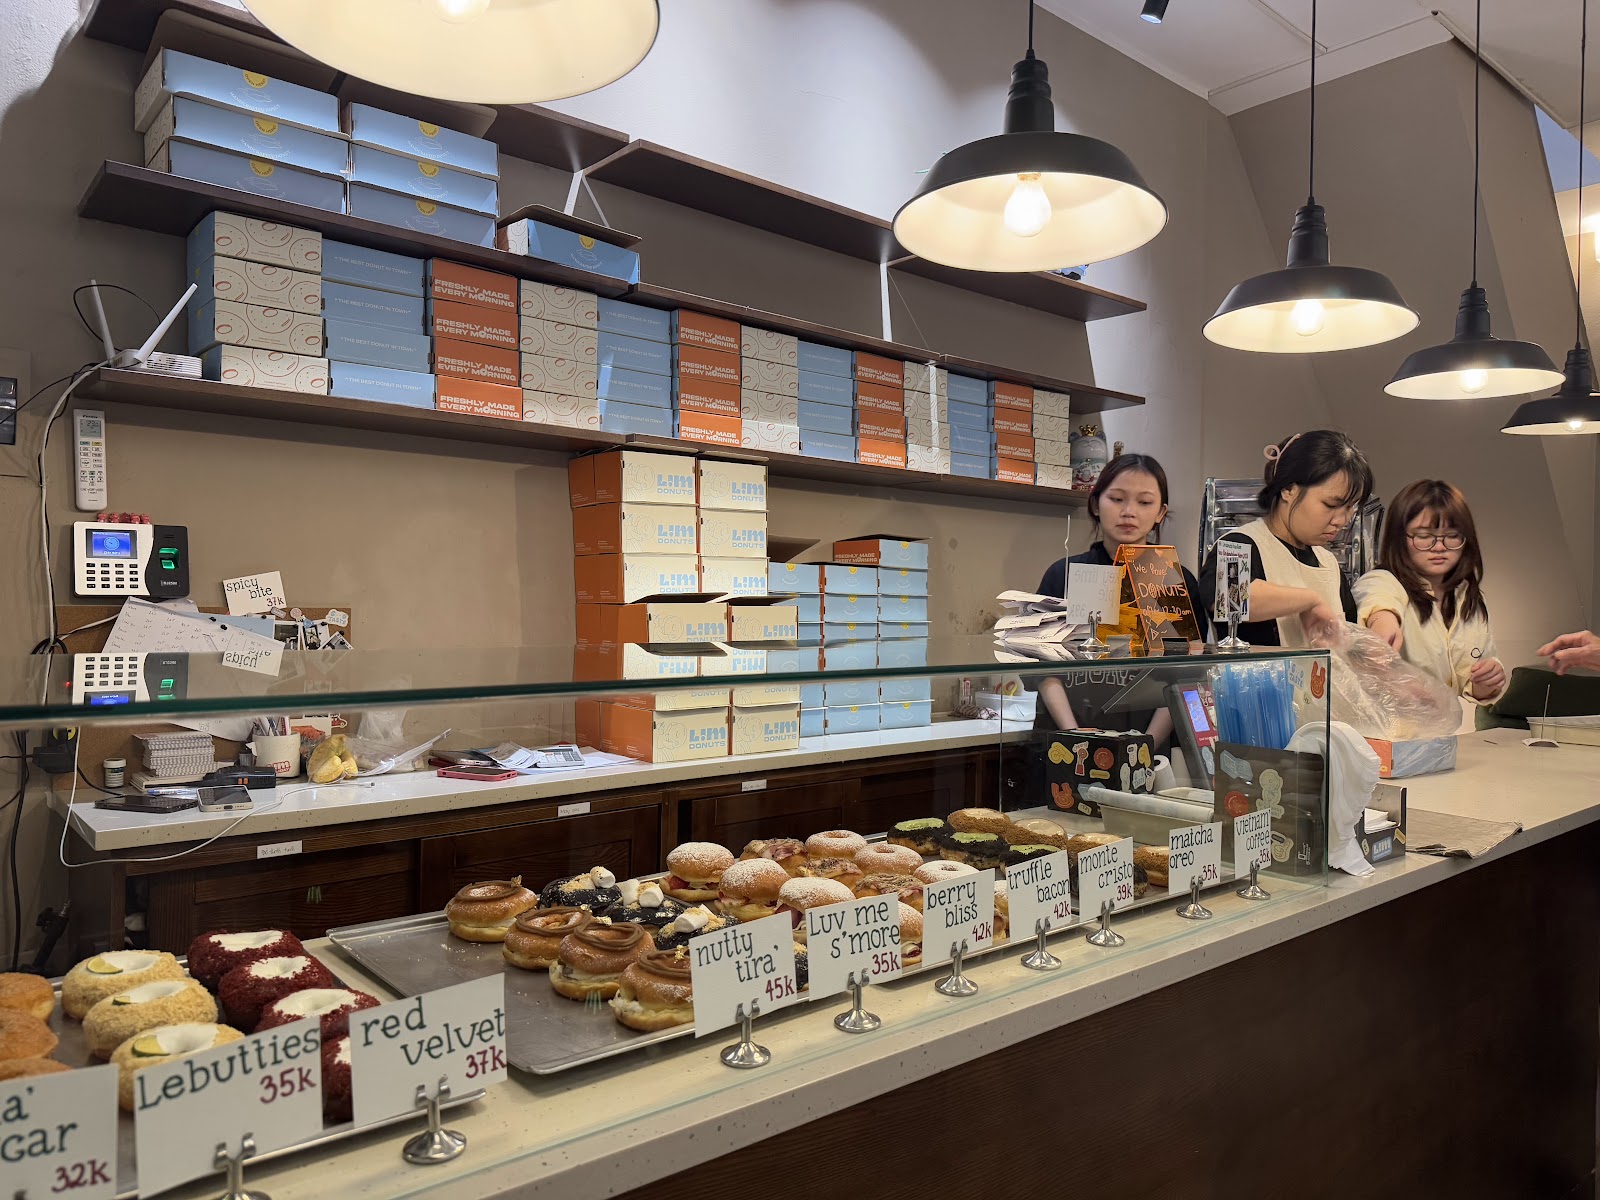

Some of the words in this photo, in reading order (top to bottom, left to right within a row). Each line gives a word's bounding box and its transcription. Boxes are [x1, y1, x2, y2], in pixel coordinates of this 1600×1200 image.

[435, 279, 479, 293] FRESHLY
[483, 289, 510, 300] MADE
[435, 286, 467, 298] EVERY
[469, 293, 514, 308] MORNING
[436, 318, 480, 330] FRESHLY
[484, 326, 511, 336] MADE
[436, 325, 468, 336] EVERY
[470, 331, 515, 344] MORNING
[681, 327, 712, 338] FRESHLY
[714, 334, 735, 343] MADE
[681, 333, 704, 342] EVERY
[705, 338, 738, 349] MORNING
[438, 357, 482, 368] FRESHLY
[485, 364, 512, 374] MADE
[438, 363, 470, 374] EVERY
[472, 369, 516, 381] MORNING
[681, 361, 713, 370] FRESHLY
[706, 371, 738, 380] MORNING
[440, 395, 484, 407] FRESHLY
[488, 402, 515, 410] MADE
[681, 393, 713, 402] FRESHLY
[681, 399, 704, 408] EVERY
[706, 402, 738, 412] MORNING
[440, 402, 472, 412] EVERY
[474, 406, 520, 418] MORNING
[682, 426, 714, 435] FRESHLY
[706, 436, 739, 444] MORNING
[226, 578, 258, 593] spicy
[248, 587, 272, 599] bite
[1138, 583, 1188, 599] DONUTS
[1171, 825, 1213, 850] matcha
[1246, 830, 1270, 851] coffee
[1080, 845, 1118, 874] monte
[1170, 850, 1194, 869] oreo
[1008, 859, 1052, 890] truffle
[1099, 861, 1134, 888] cristo
[1202, 864, 1218, 881] 35k
[927, 881, 976, 910] berry
[1036, 879, 1070, 903] bacon
[1117, 883, 1132, 901] 39k
[809, 911, 845, 936] Luv
[854, 902, 889, 926] me
[945, 903, 978, 928] bliss
[1054, 900, 1070, 919] 42k
[830, 925, 901, 959] s'more
[972, 921, 992, 942] 42k
[696, 929, 753, 967] nutty
[872, 951, 901, 975] 35k
[765, 975, 795, 1001] 45k
[361, 996, 427, 1047] red
[400, 1008, 504, 1065] velvet
[136, 1026, 320, 1111] Lebutties
[465, 1045, 507, 1078] 37k
[260, 1067, 316, 1104] 35k
[50, 1158, 112, 1193] 32k
